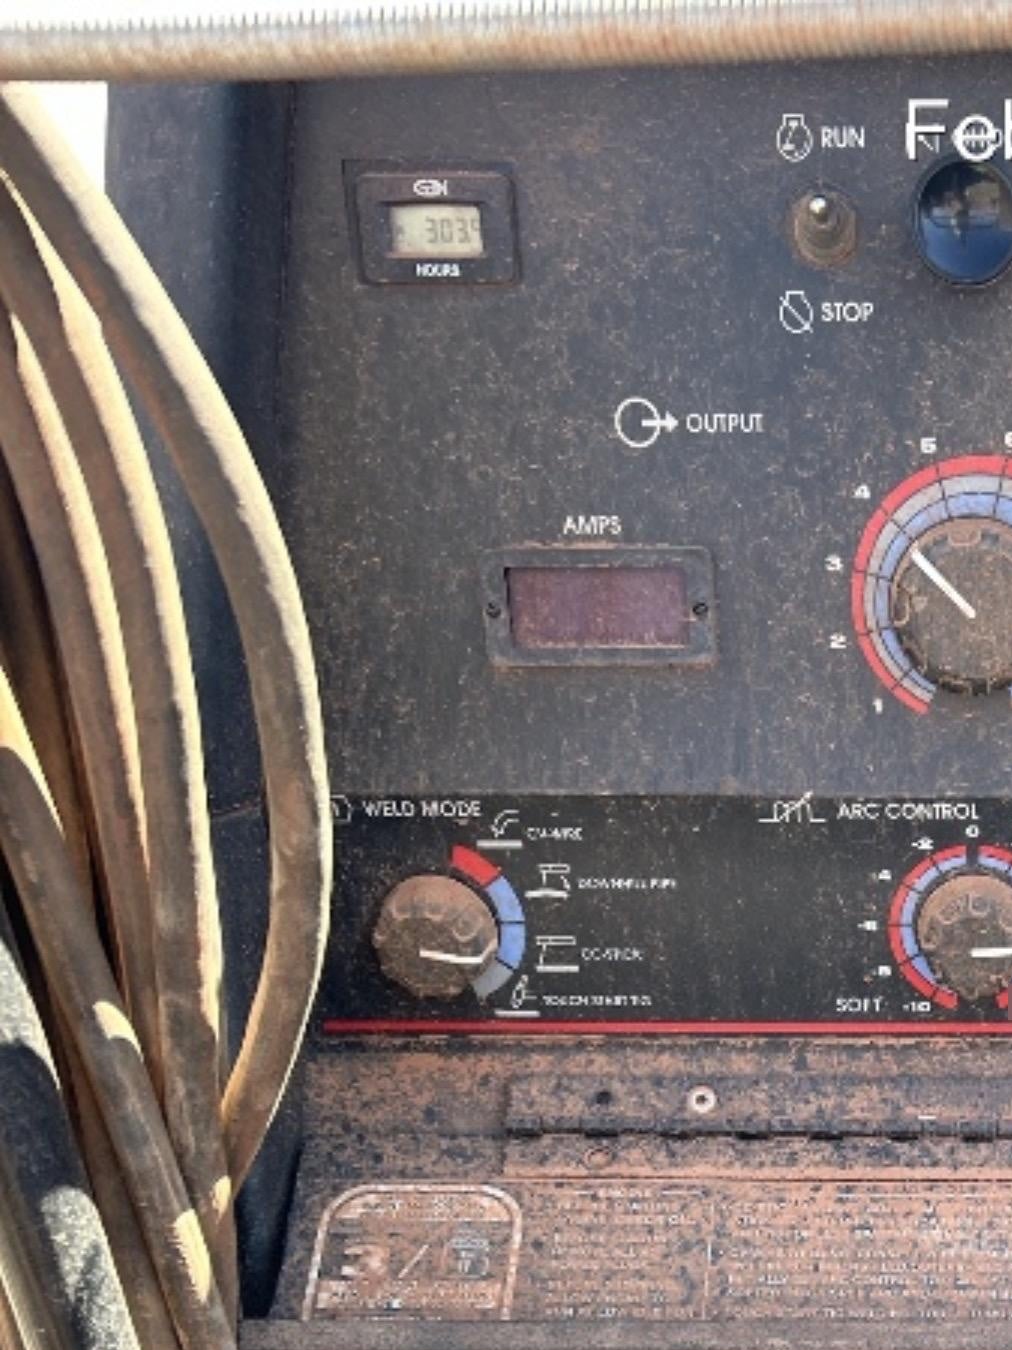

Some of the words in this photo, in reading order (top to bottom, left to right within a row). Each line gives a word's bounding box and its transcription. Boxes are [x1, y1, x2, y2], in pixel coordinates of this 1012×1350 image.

[820, 127, 866, 149] RUN
[820, 302, 874, 323] STOP
[685, 412, 765, 433] OUTPUT
[920, 437, 937, 453] 5
[854, 485, 871, 500] 4
[563, 514, 623, 536] AMPS
[824, 555, 844, 572] 3
[829, 634, 848, 650] 2
[872, 699, 883, 715] 1
[362, 800, 416, 818] WELD
[421, 800, 483, 818] MODE
[836, 802, 881, 821] ARC
[885, 802, 980, 821] CONTROL
[964, 824, 980, 839] 0
